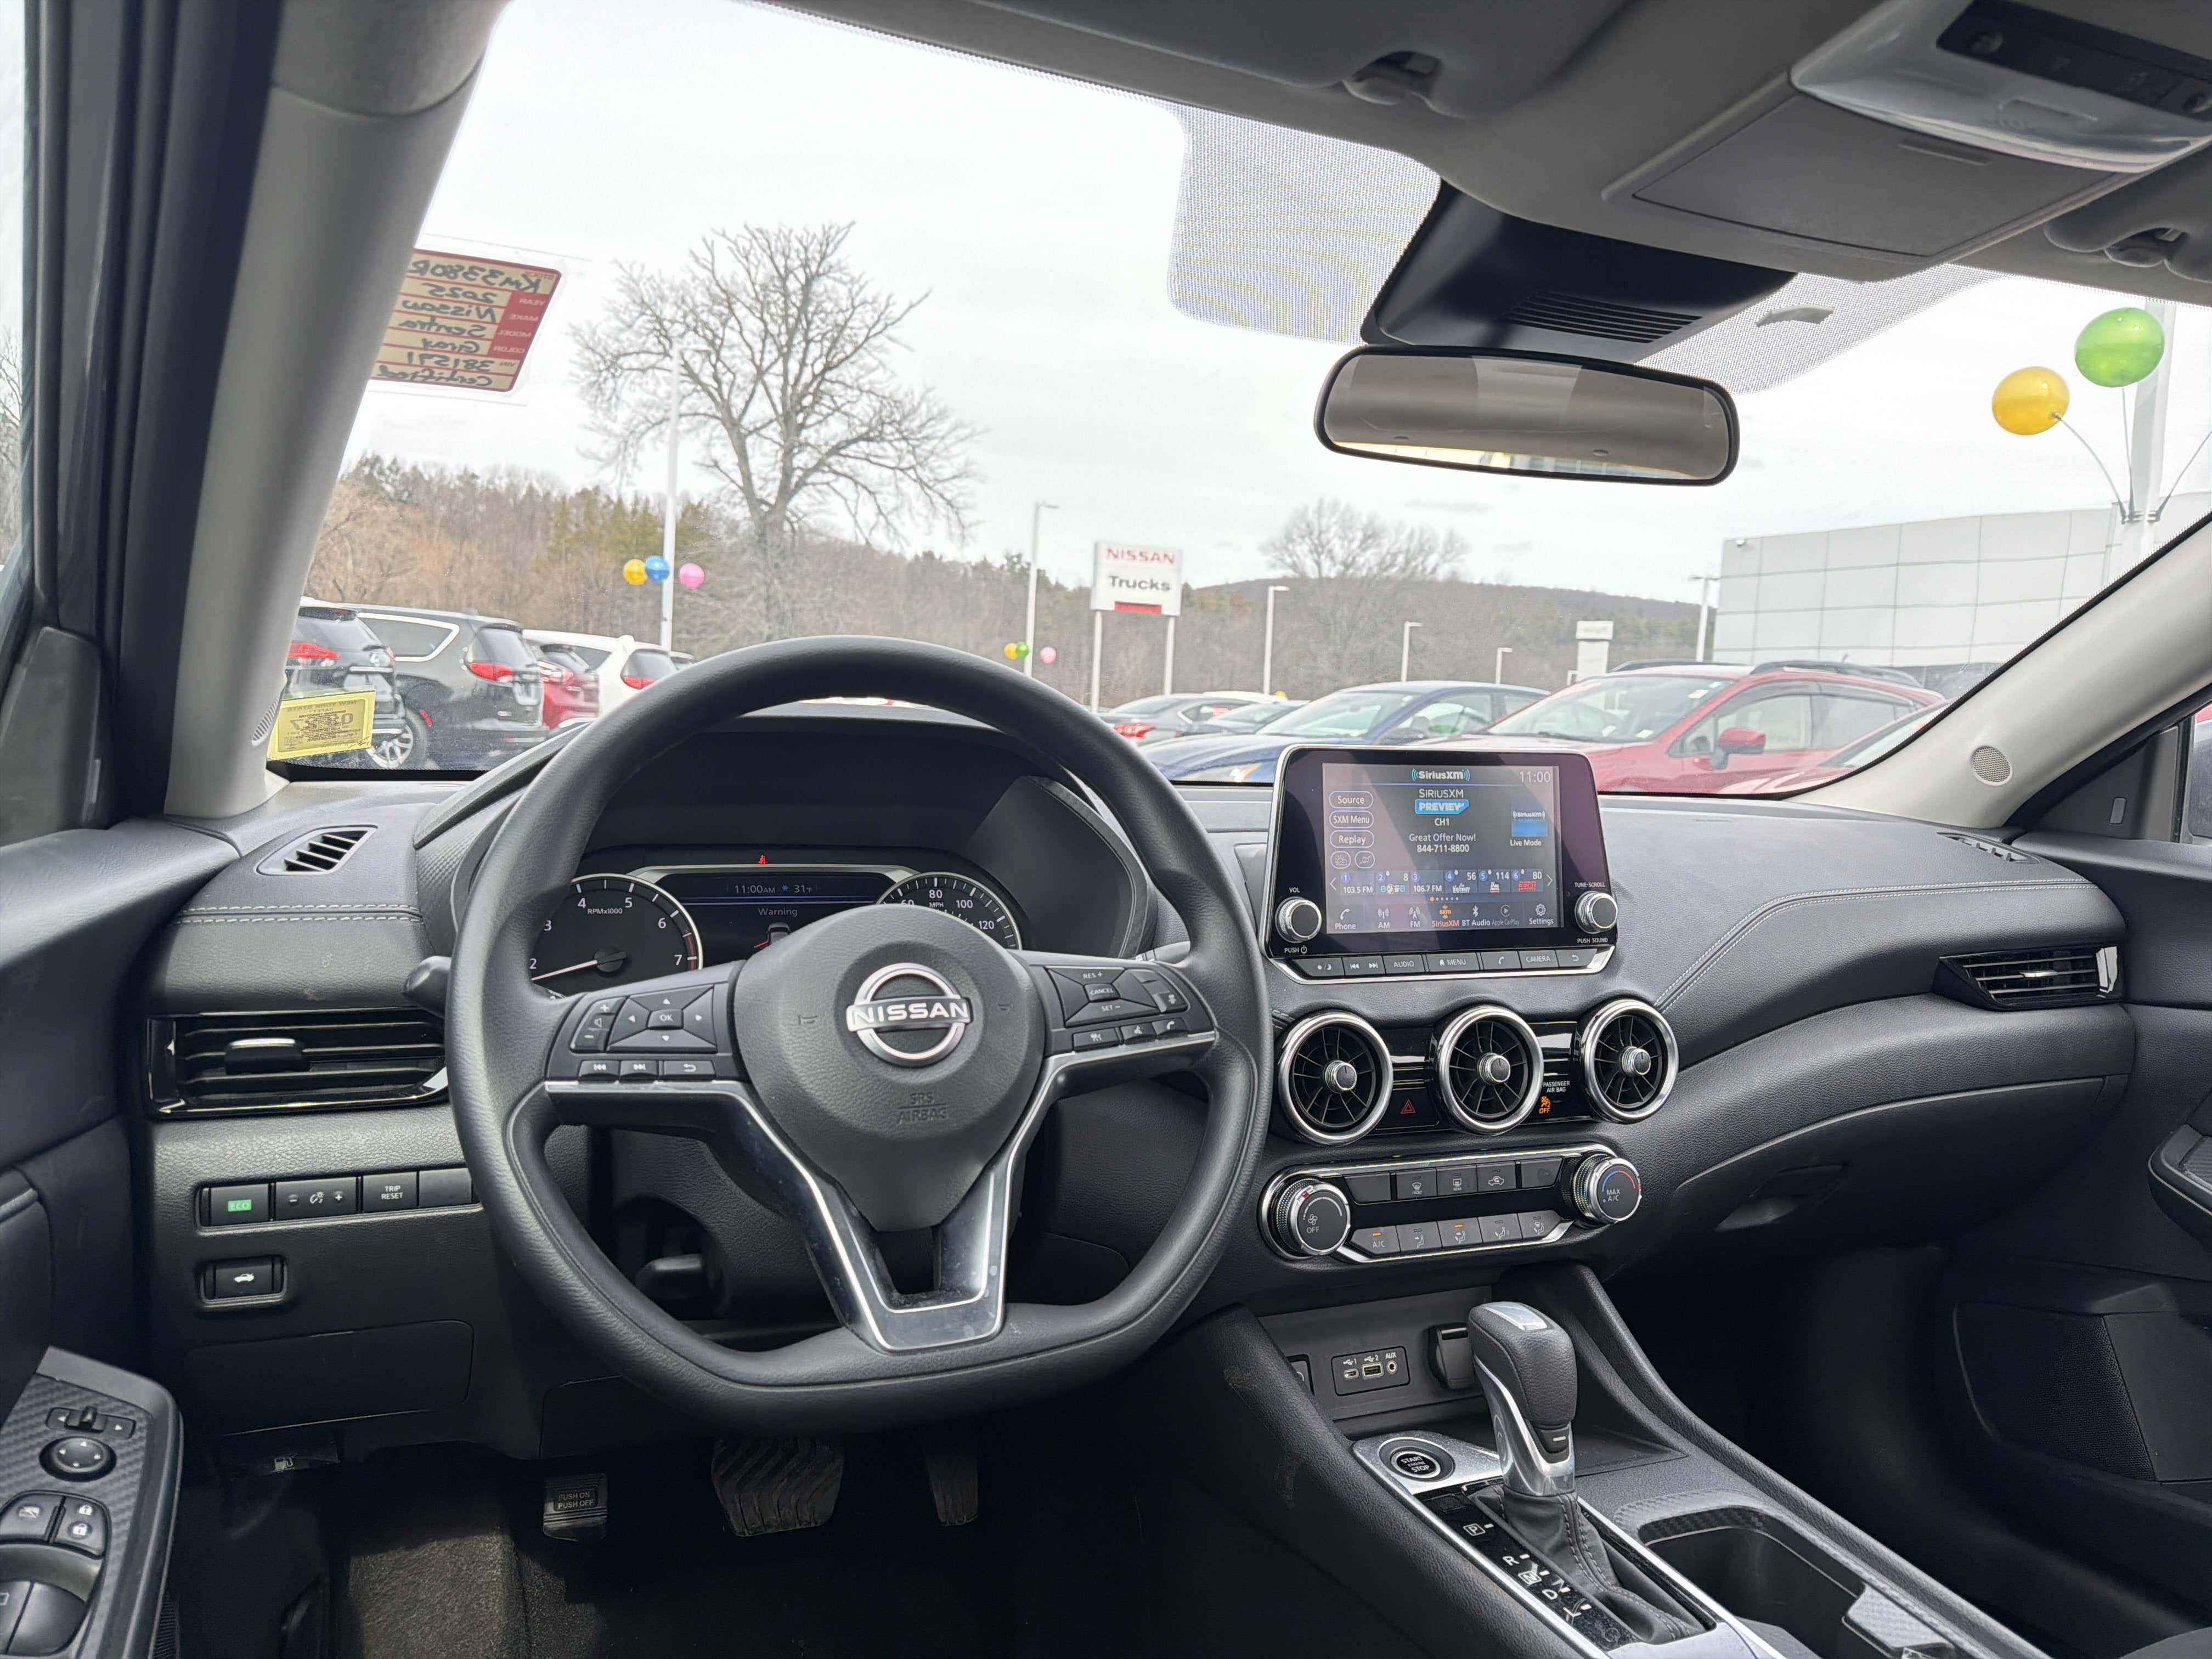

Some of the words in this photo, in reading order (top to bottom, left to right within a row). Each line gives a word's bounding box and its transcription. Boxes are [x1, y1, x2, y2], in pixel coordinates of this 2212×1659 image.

[1107, 548, 1175, 564] NISSAN
[1109, 575, 1171, 591] Trucks
[1520, 771, 1551, 783] 11:00
[1419, 788, 1464, 798] SIRIUSXM
[1337, 795, 1365, 804] Source
[1419, 802, 1465, 811] PREVIEW
[1333, 815, 1348, 823] SXM
[1350, 815, 1370, 823] Menu
[1434, 817, 1449, 826] CH1
[1338, 834, 1367, 845] Replay
[1409, 833, 1431, 842] Great
[1433, 833, 1454, 841] Offer
[1455, 833, 1476, 842] Now!
[1417, 844, 1470, 853] 844-711-8800
[1403, 873, 1409, 881] 8
[1466, 872, 1476, 881] 56
[1496, 871, 1510, 880] 114
[1532, 871, 1542, 880] 80
[929, 889, 943, 899] 80
[577, 897, 586, 909] 4
[624, 897, 633, 909] 5
[956, 899, 973, 909] 100
[758, 908, 798, 917] Warning
[544, 919, 552, 931] 3
[658, 917, 667, 929] 6
[978, 920, 995, 930] 120
[1504, 918, 1520, 927] CarPlay
[1529, 918, 1554, 926] Settings
[529, 958, 538, 969] 2
[674, 954, 682, 966] 7
[1090, 987, 1115, 996] CANCEL
[854, 1002, 968, 1024] NISSAN
[659, 1014, 674, 1022] OK
[897, 1108, 949, 1124] AIRBAG
[381, 1192, 404, 1200] RESET
[1606, 1189, 1621, 1197] MAX
[1306, 1226, 1320, 1234] OFF
[1372, 1240, 1386, 1249] A/C
[1385, 1351, 1397, 1359] AUX
[558, 1493, 578, 1501] PUSH
[1503, 1555, 1520, 1566] R
[1542, 1589, 1558, 1600] D
